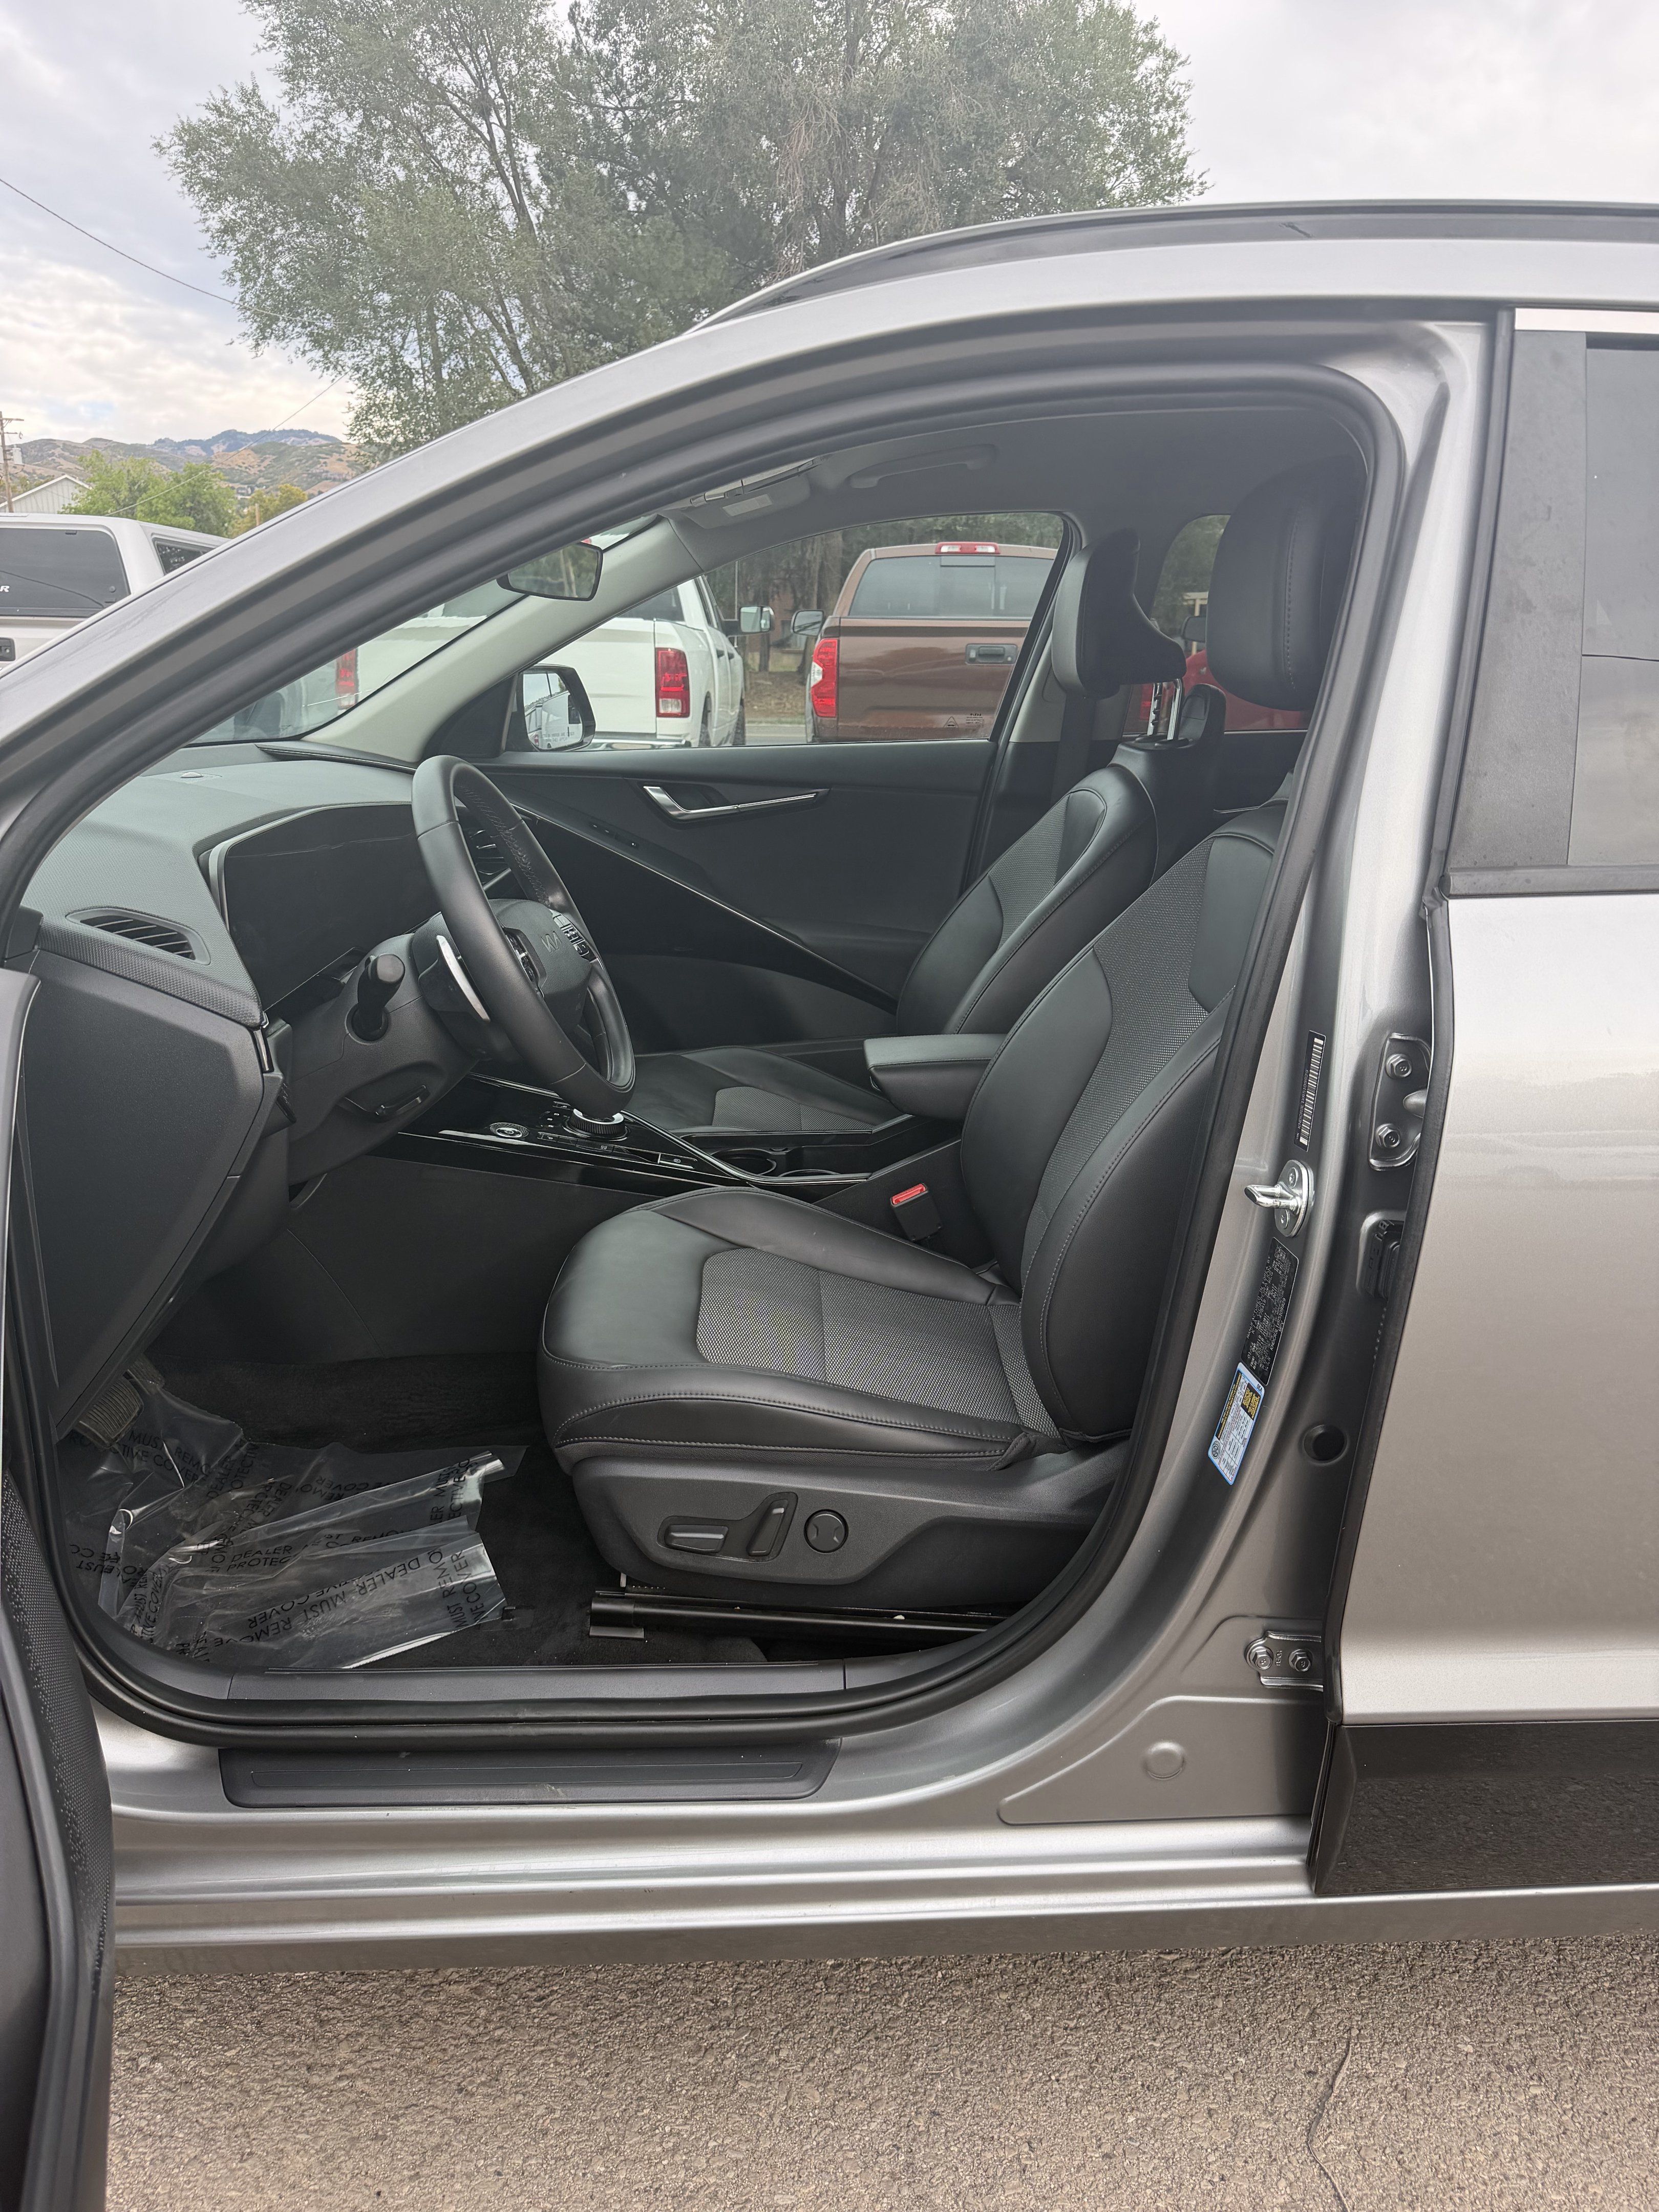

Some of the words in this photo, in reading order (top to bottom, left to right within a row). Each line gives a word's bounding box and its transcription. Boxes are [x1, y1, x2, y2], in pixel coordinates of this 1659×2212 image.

[231, 1545, 293, 1563] DEALER
[358, 1557, 421, 1596] DEALER
[451, 1550, 481, 1603] COVER
[304, 1591, 347, 1620] MUST
